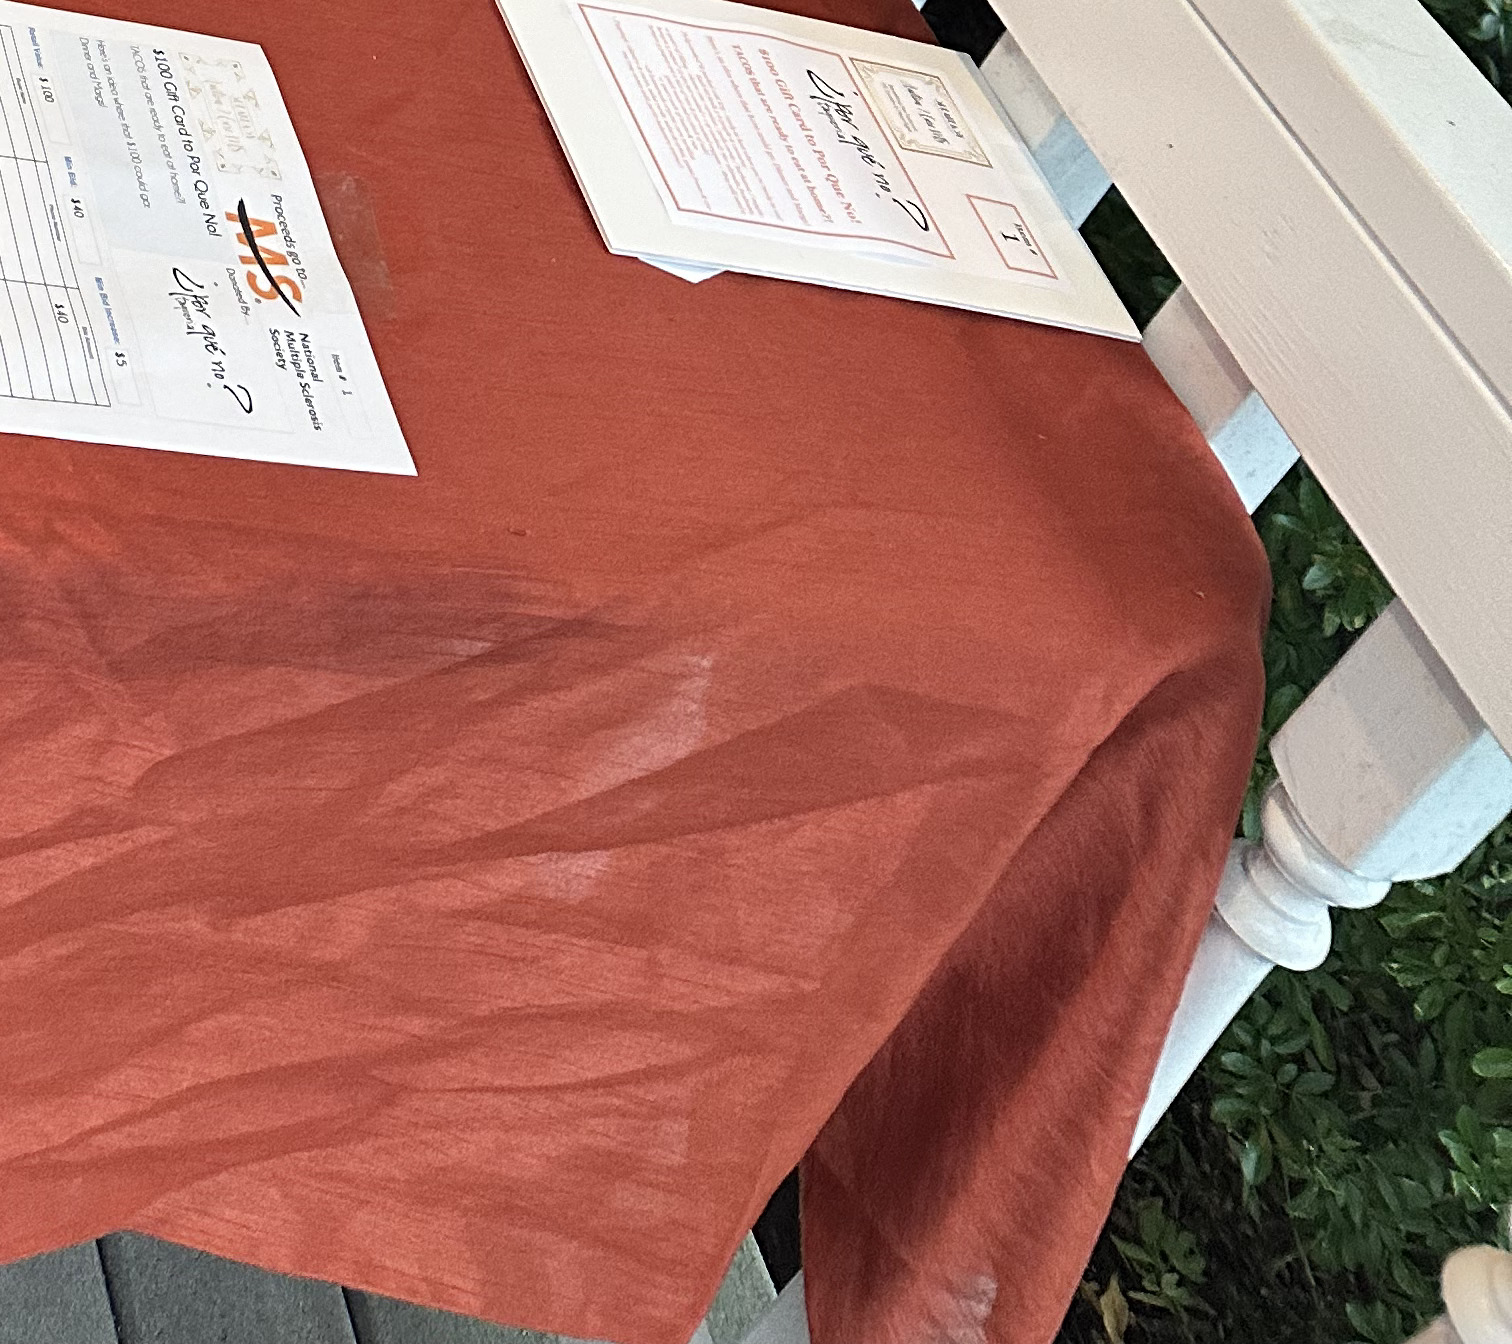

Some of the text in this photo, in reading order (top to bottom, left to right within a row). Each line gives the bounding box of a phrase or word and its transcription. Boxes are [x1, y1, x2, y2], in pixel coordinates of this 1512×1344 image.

[97, 39, 109, 62] Here's
[130, 45, 145, 73] TACOS
[78, 37, 107, 107] Dinner and Margs!
[139, 75, 150, 90] that
[106, 76, 118, 95] idea
[113, 97, 125, 121] where
[144, 91, 154, 106] are
[121, 123, 132, 139] that
[149, 107, 163, 131] ready
[152, 49, 221, 236] $100 Gift Card to Por Que No!
[732, 45, 832, 222] TACOS that are ready to eat at home?!
[758, 48, 861, 223] $100 Gift Card to Por Que No!
[126, 141, 141, 164] $100
[160, 143, 172, 159] eat
[837, 133, 884, 168] qué
[165, 160, 176, 170] at
[133, 165, 148, 192] could
[170, 172, 185, 204] home?!
[271, 194, 301, 265] Proceeds go
[1013, 223, 1031, 246] Item
[223, 211, 305, 304] MS
[94, 276, 103, 291] Min
[225, 267, 247, 304] Donated
[98, 292, 109, 306] Bid
[54, 303, 68, 323] $40
[186, 324, 225, 355] qué
[269, 328, 286, 370] Society
[114, 352, 126, 366] $5
[299, 333, 322, 382] National
[331, 353, 342, 372] Item
[284, 330, 321, 430] Multiple Sclerosis
